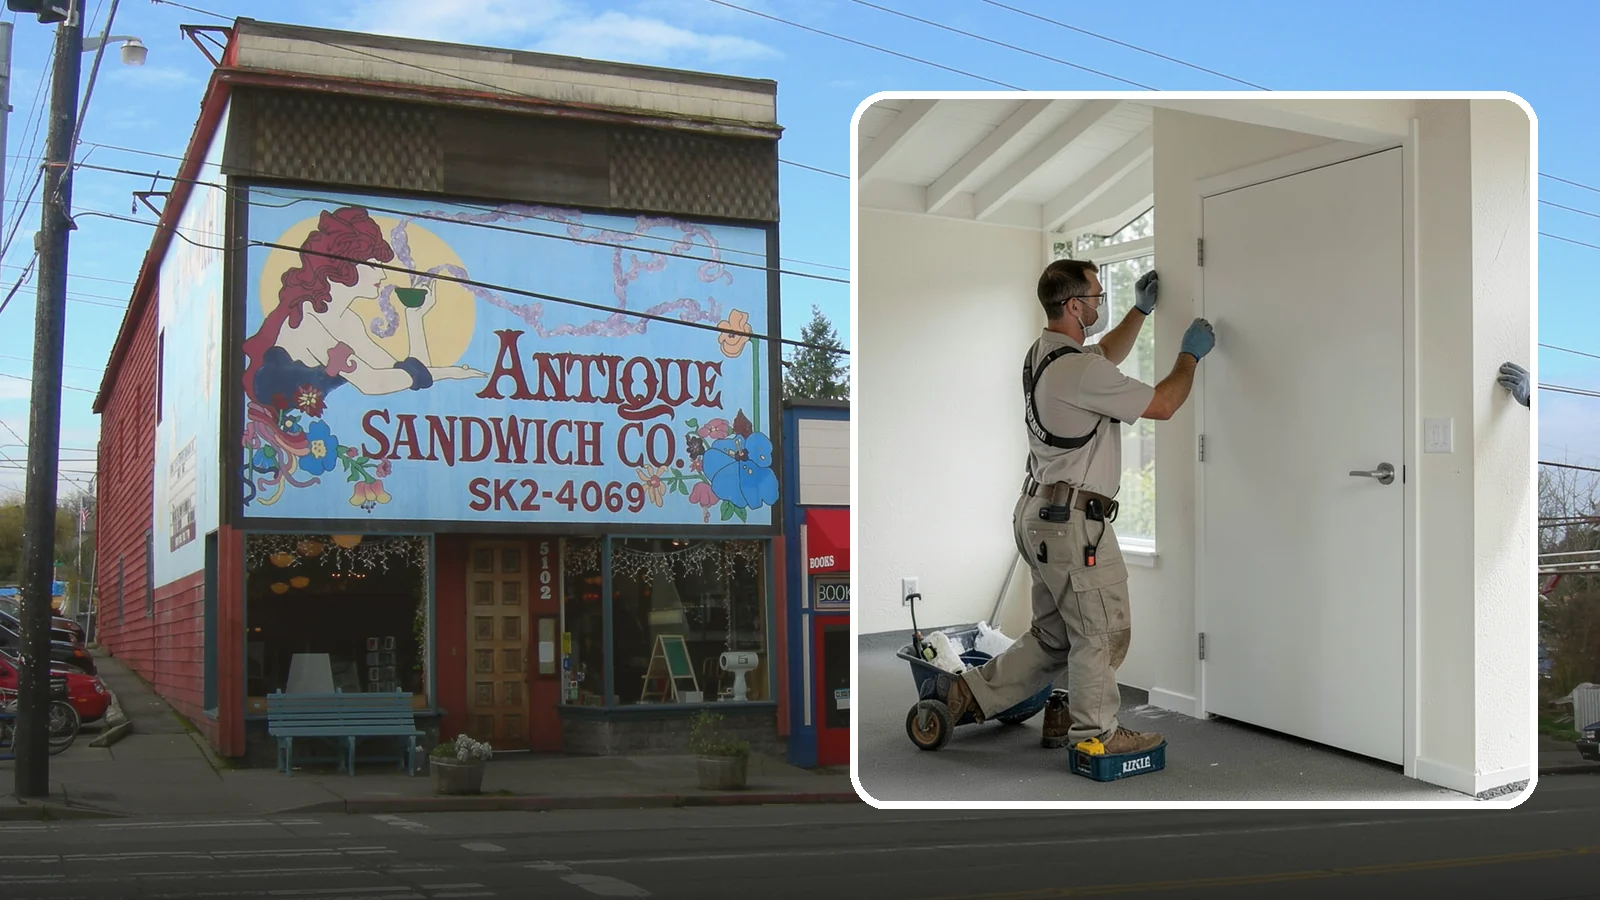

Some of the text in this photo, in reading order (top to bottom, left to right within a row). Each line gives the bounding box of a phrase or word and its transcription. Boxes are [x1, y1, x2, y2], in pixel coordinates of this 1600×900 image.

[476, 330, 723, 420] ANTIQUE
[362, 408, 686, 468] SANDWICH CO.
[468, 477, 646, 514] SK2-4069
[540, 541, 551, 600] 5102
[809, 554, 835, 569] BOOKS
